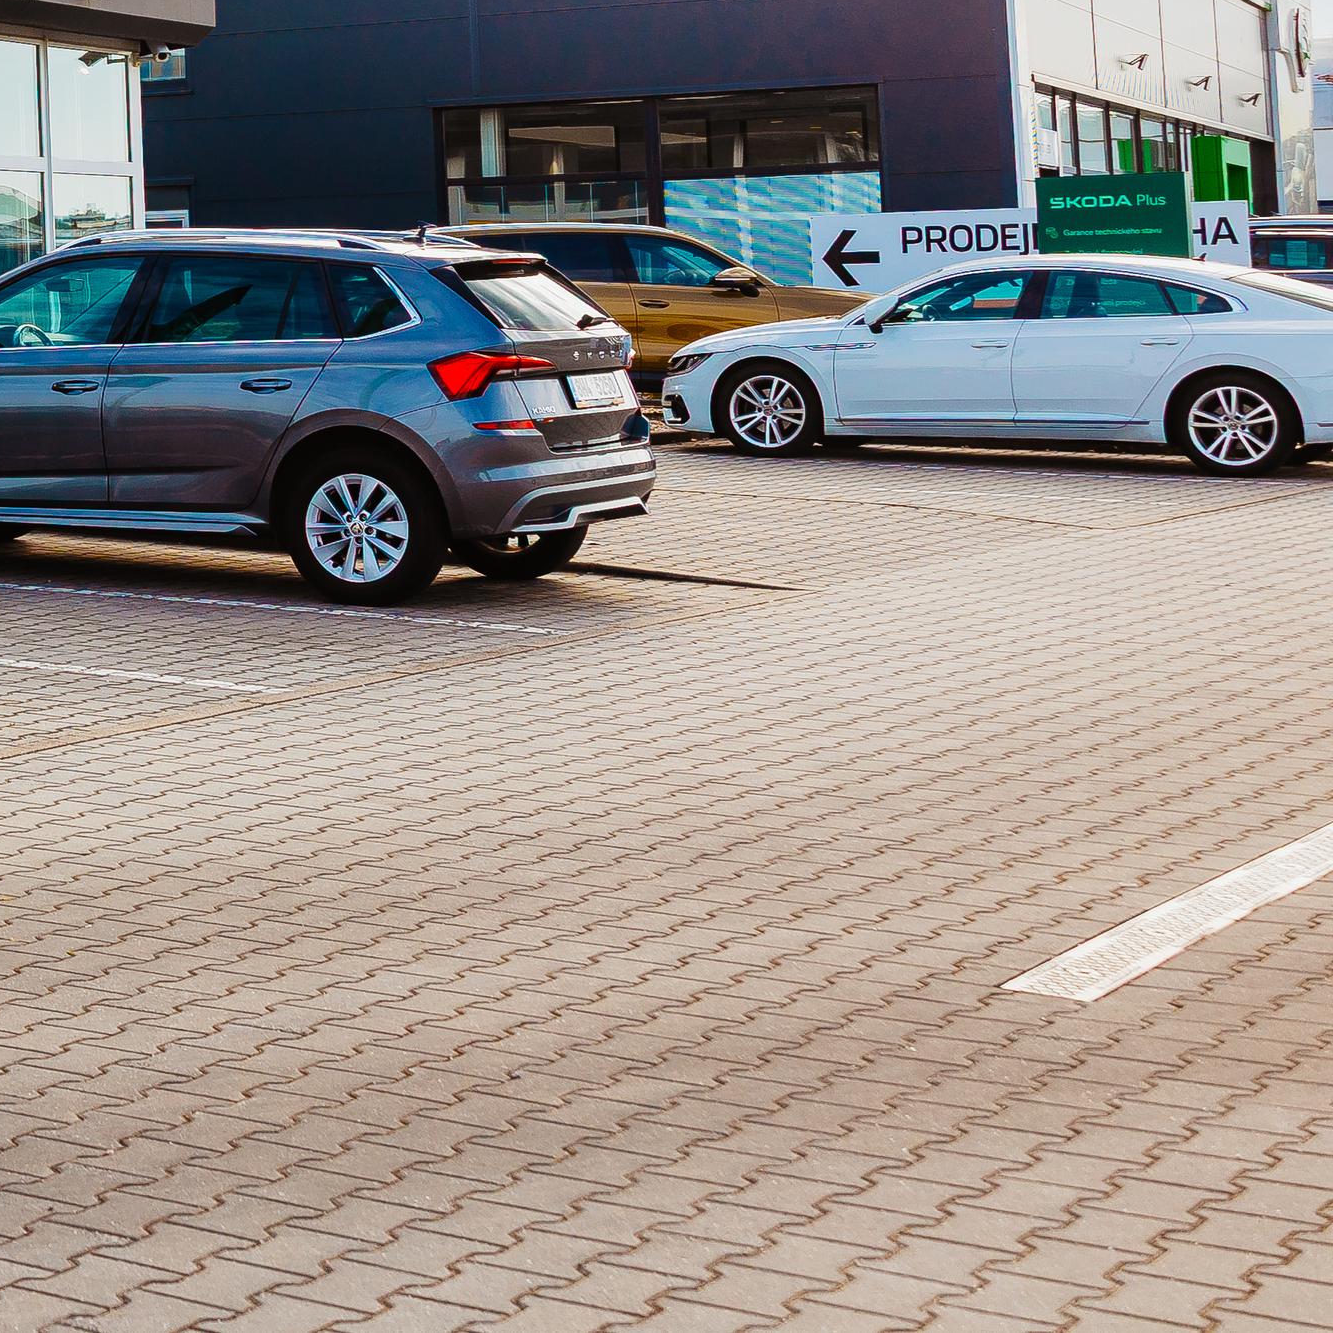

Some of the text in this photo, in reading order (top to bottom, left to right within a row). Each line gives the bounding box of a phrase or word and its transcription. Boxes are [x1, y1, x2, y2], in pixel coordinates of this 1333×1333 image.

[1136, 193, 1167, 207] Plus
[901, 217, 1239, 255] PRODEJ HA
[1063, 228, 1094, 237] Garance
